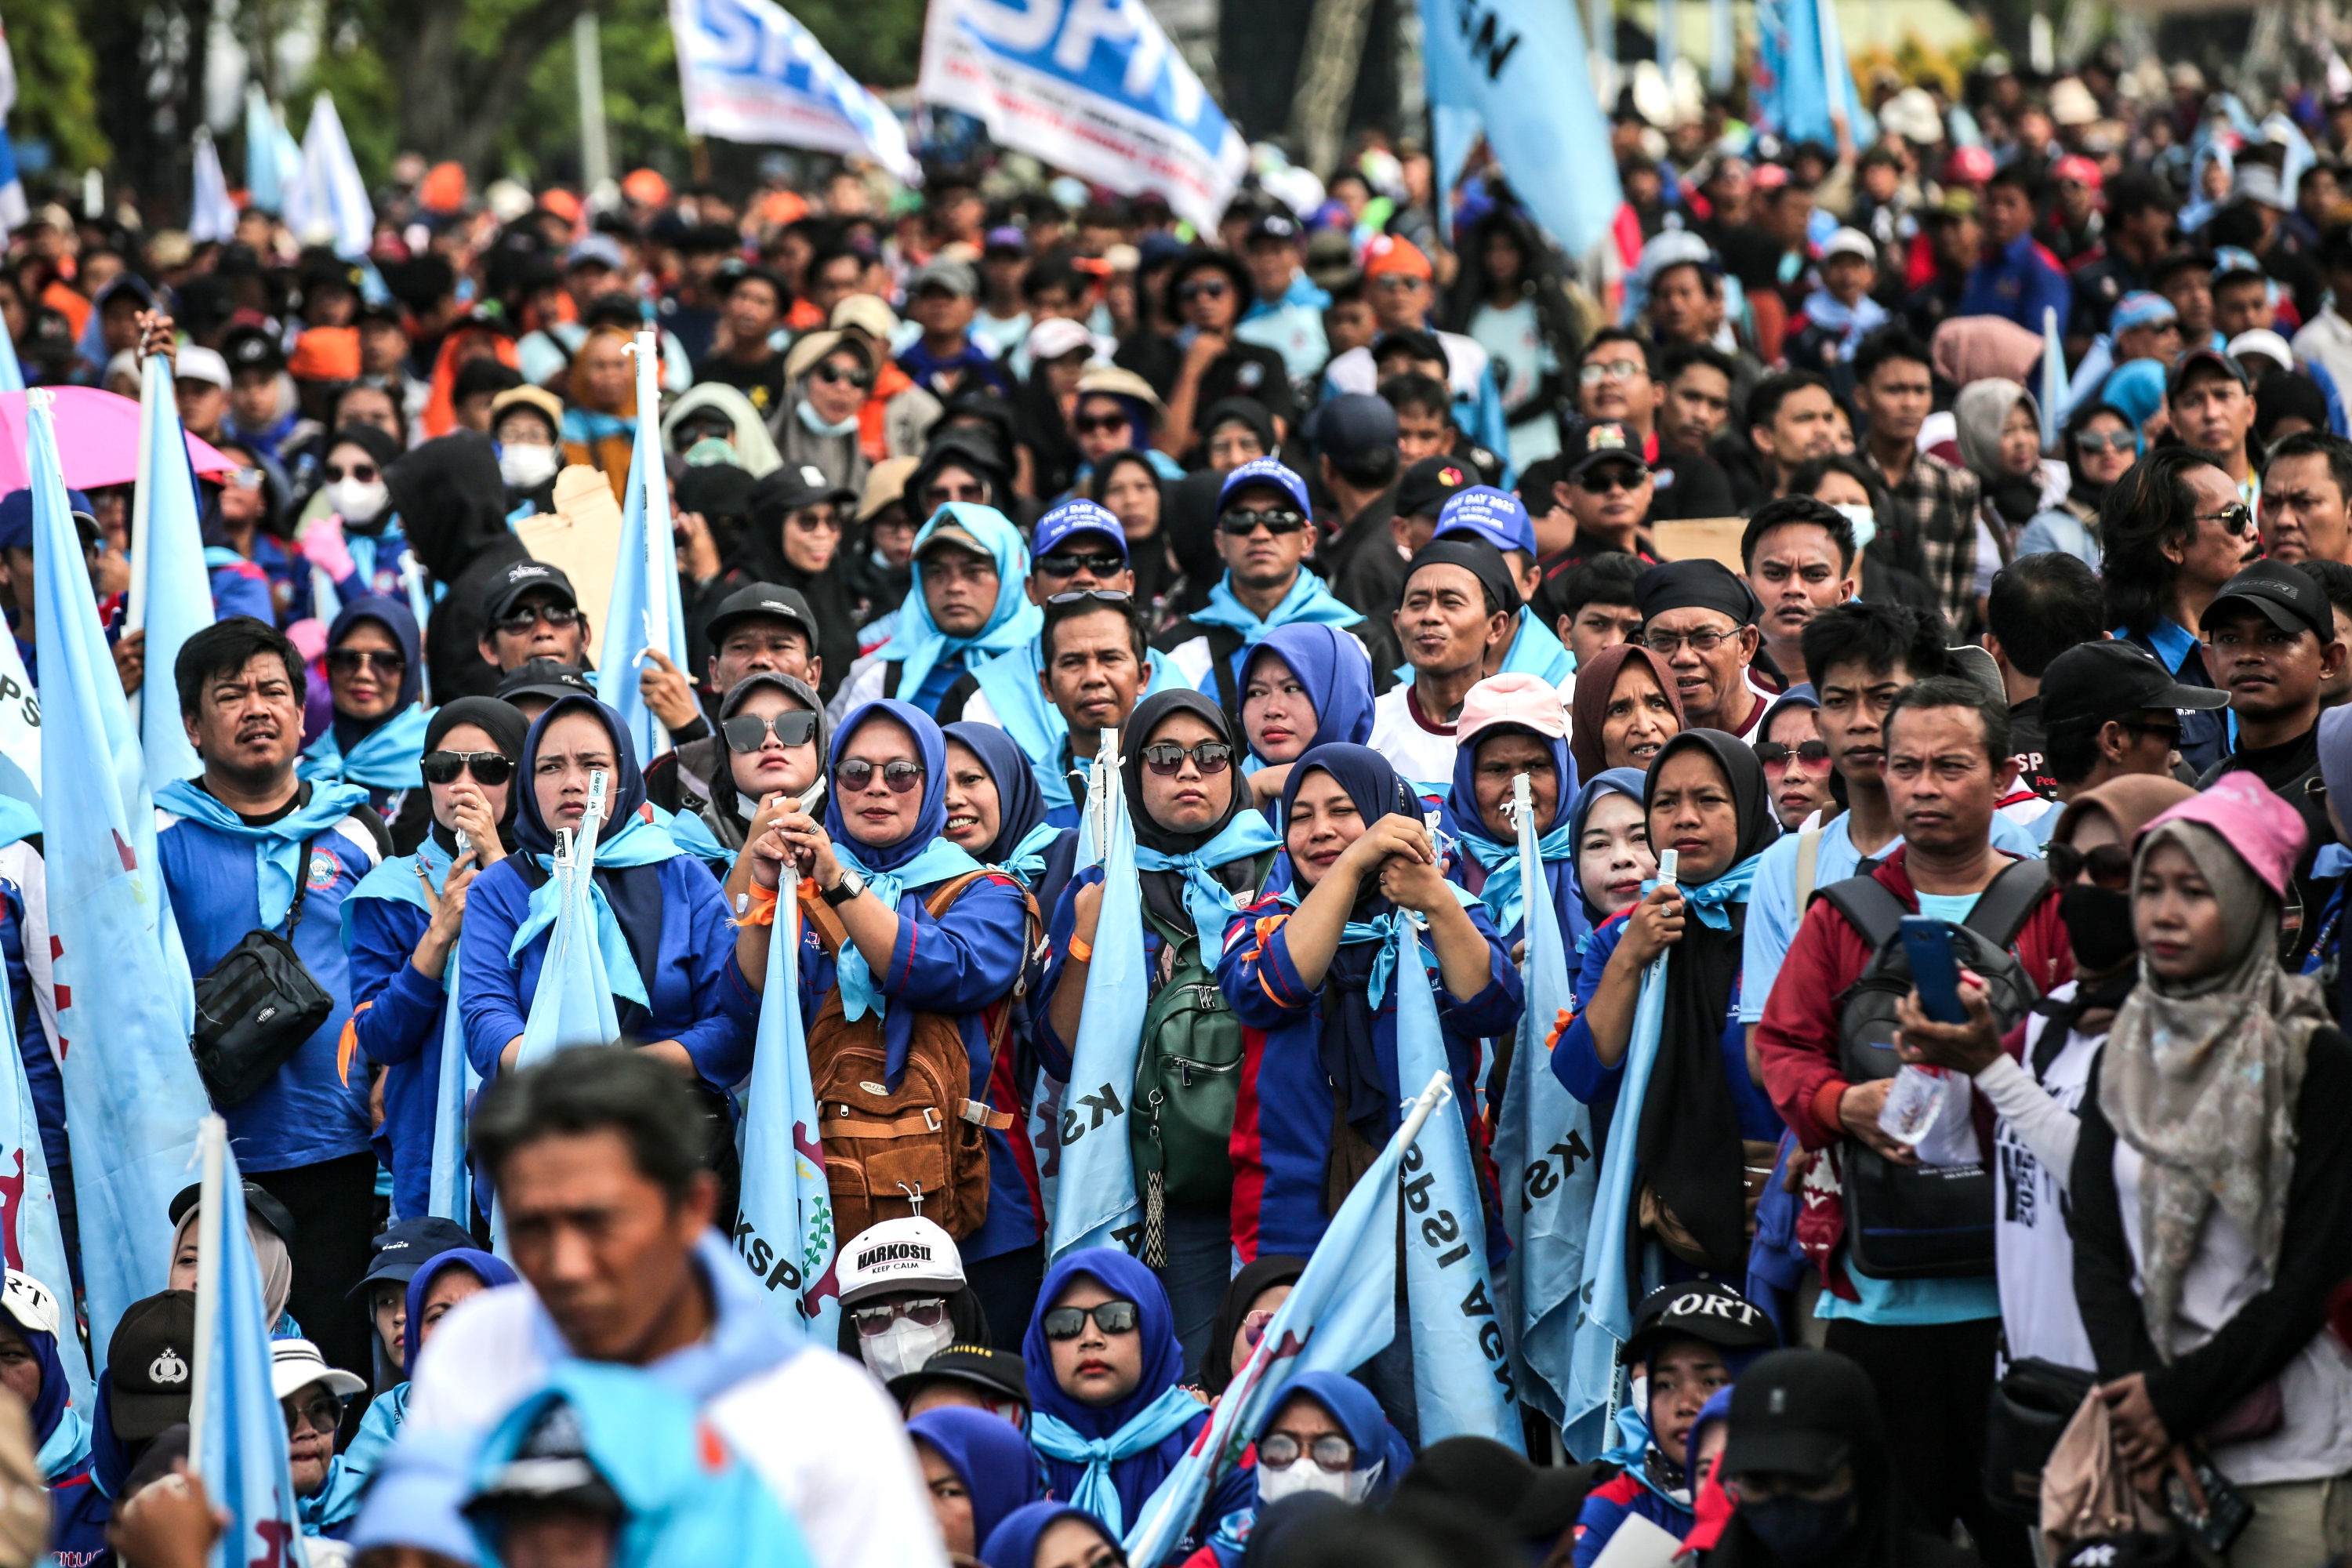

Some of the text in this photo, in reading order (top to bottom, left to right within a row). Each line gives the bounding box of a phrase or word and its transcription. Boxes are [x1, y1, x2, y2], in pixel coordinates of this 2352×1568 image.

[1069, 503, 1094, 514] DAY
[1465, 493, 1488, 506] DAY
[1488, 495, 1515, 515] 2025
[561, 674, 581, 684] FILA
[872, 1265, 891, 1275] KEEP
